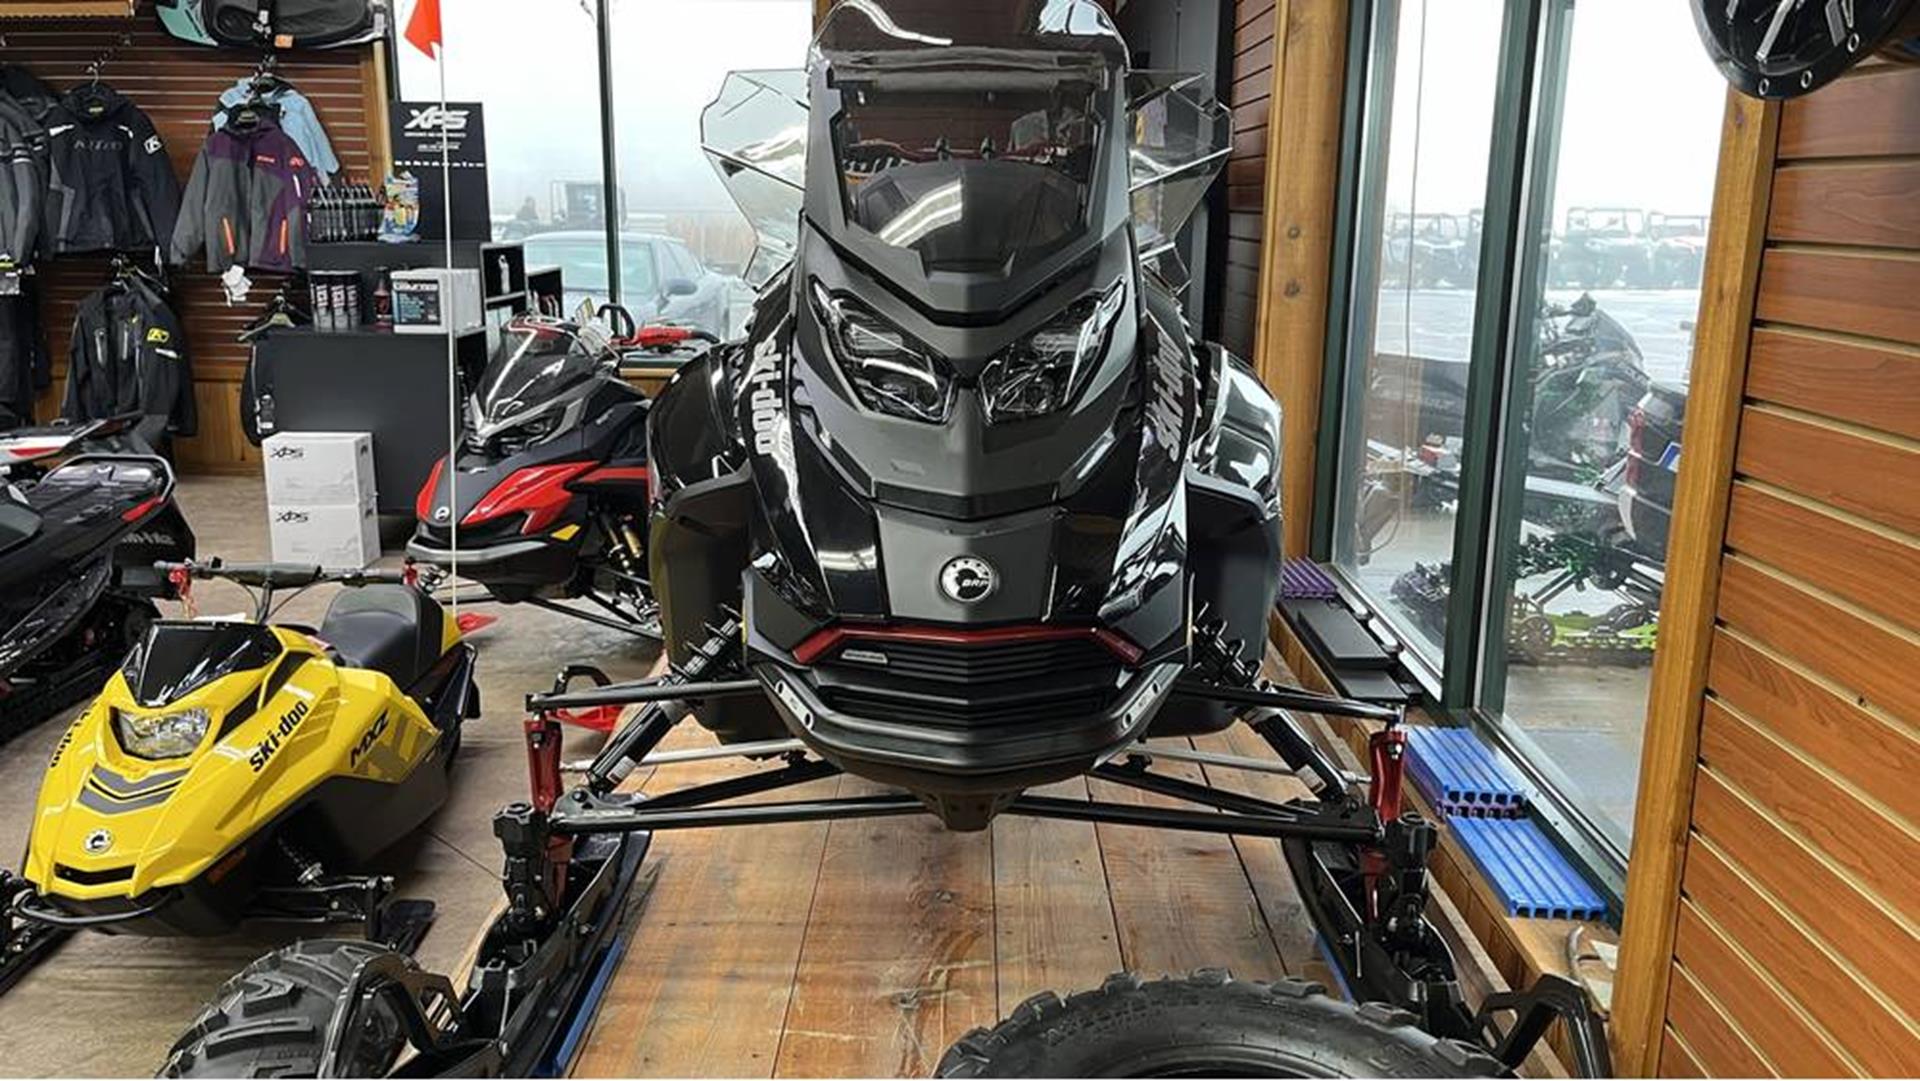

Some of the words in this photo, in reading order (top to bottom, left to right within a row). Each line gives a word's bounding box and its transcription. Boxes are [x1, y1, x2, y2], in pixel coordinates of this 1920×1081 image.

[404, 105, 470, 129] XPS
[269, 447, 304, 458] XPS
[275, 511, 310, 523] XPS
[350, 707, 390, 769] MXZ
